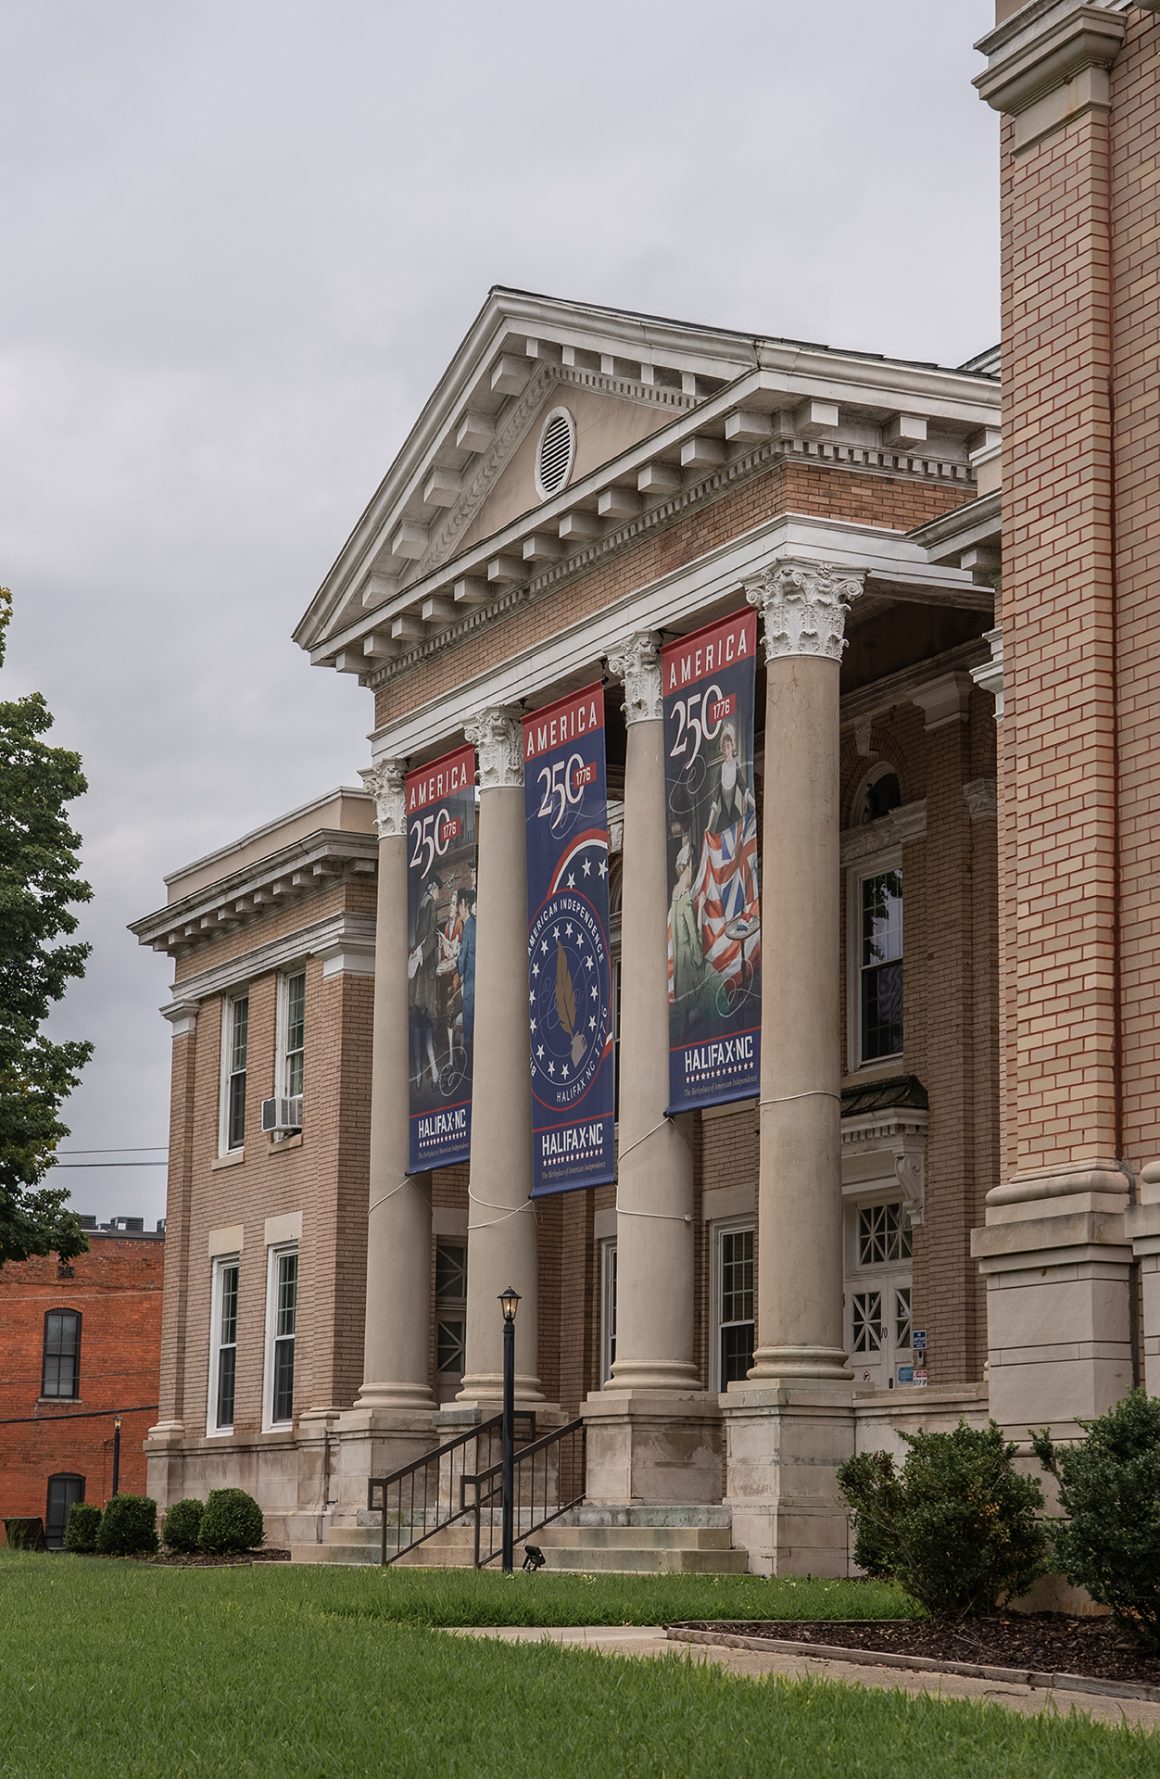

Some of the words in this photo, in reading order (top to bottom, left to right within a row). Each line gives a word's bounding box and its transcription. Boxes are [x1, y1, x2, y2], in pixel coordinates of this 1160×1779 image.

[669, 628, 747, 689] AMERICA
[526, 701, 598, 757] AMERICA
[669, 684, 724, 770] 250
[713, 698, 730, 720] 1776
[409, 762, 467, 810] AMERICA
[536, 753, 585, 830] 250
[575, 766, 591, 786] 1776
[409, 808, 451, 880] 250
[443, 821, 457, 839] 1776
[560, 898, 605, 963] INDEPENDENCE
[556, 1078, 587, 1103] HALIFAX
[585, 1060, 596, 1079] NC
